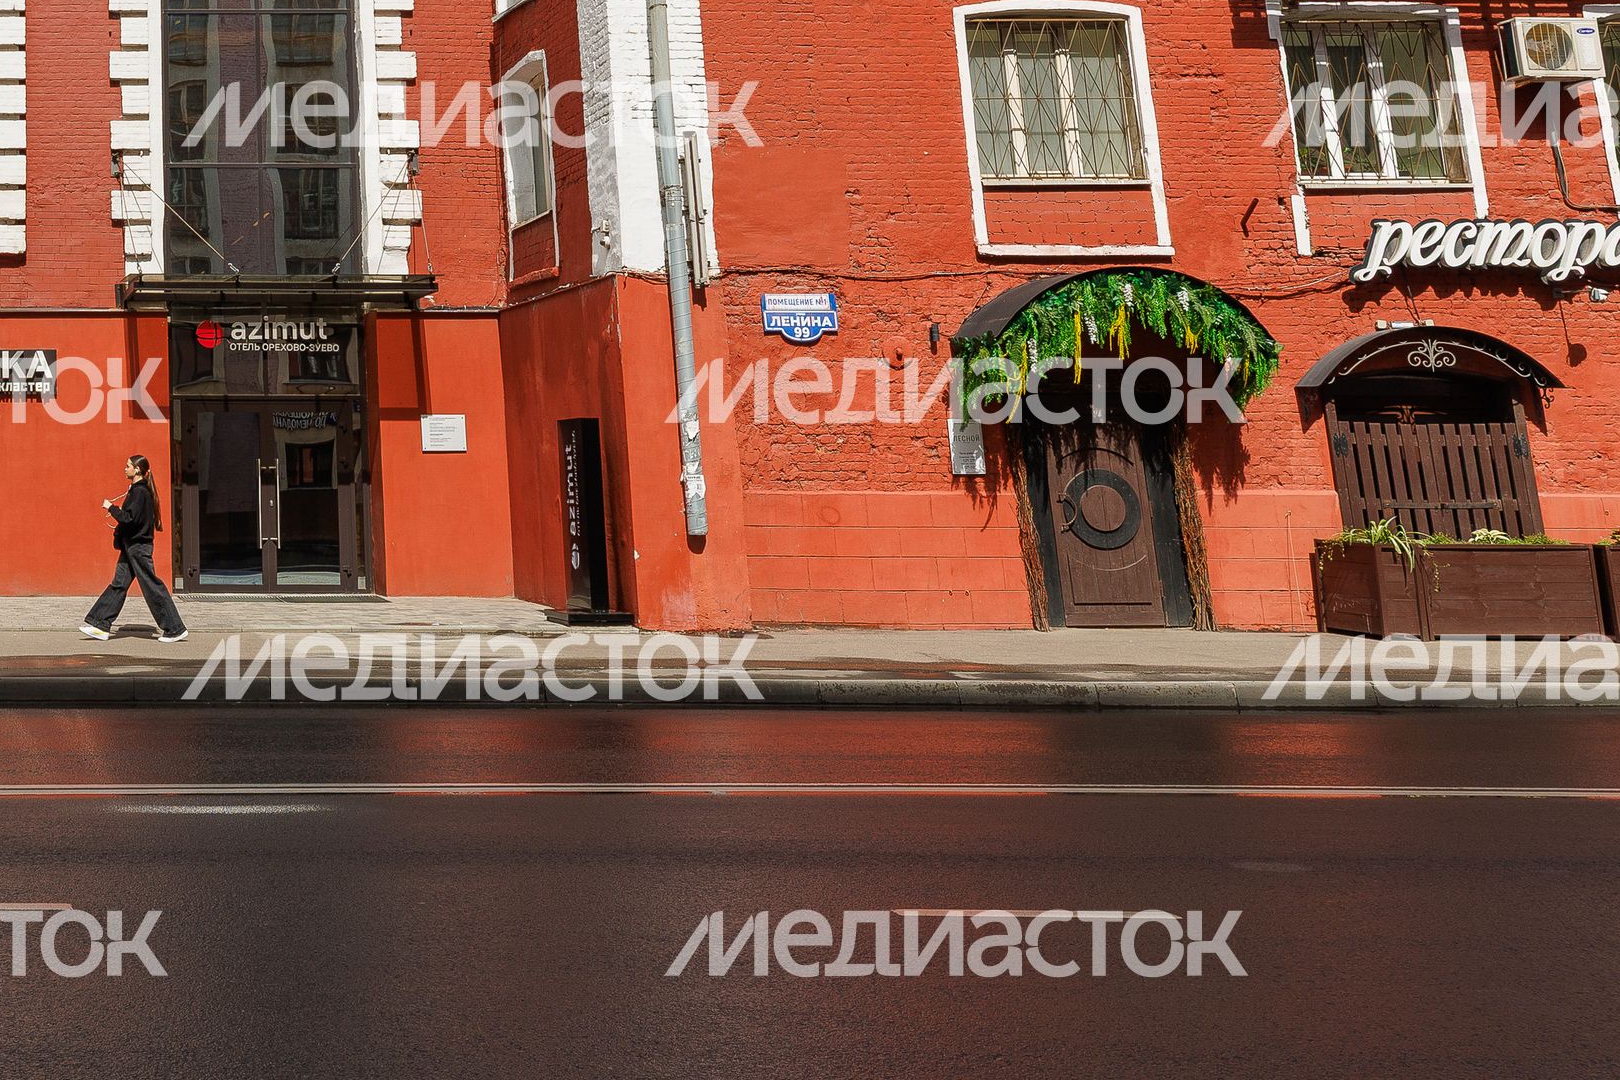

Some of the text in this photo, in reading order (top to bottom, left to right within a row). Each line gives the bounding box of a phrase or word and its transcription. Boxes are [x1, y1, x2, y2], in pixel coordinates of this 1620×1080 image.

[767, 298, 814, 307] ПОМЕЩЕНИЕ
[770, 315, 833, 327] ЛЕНИНА
[230, 315, 328, 340] azimut
[793, 326, 811, 338] 99
[229, 342, 340, 352] ОТЕЛЬ ОРЕХОВО-ЗУЕВО
